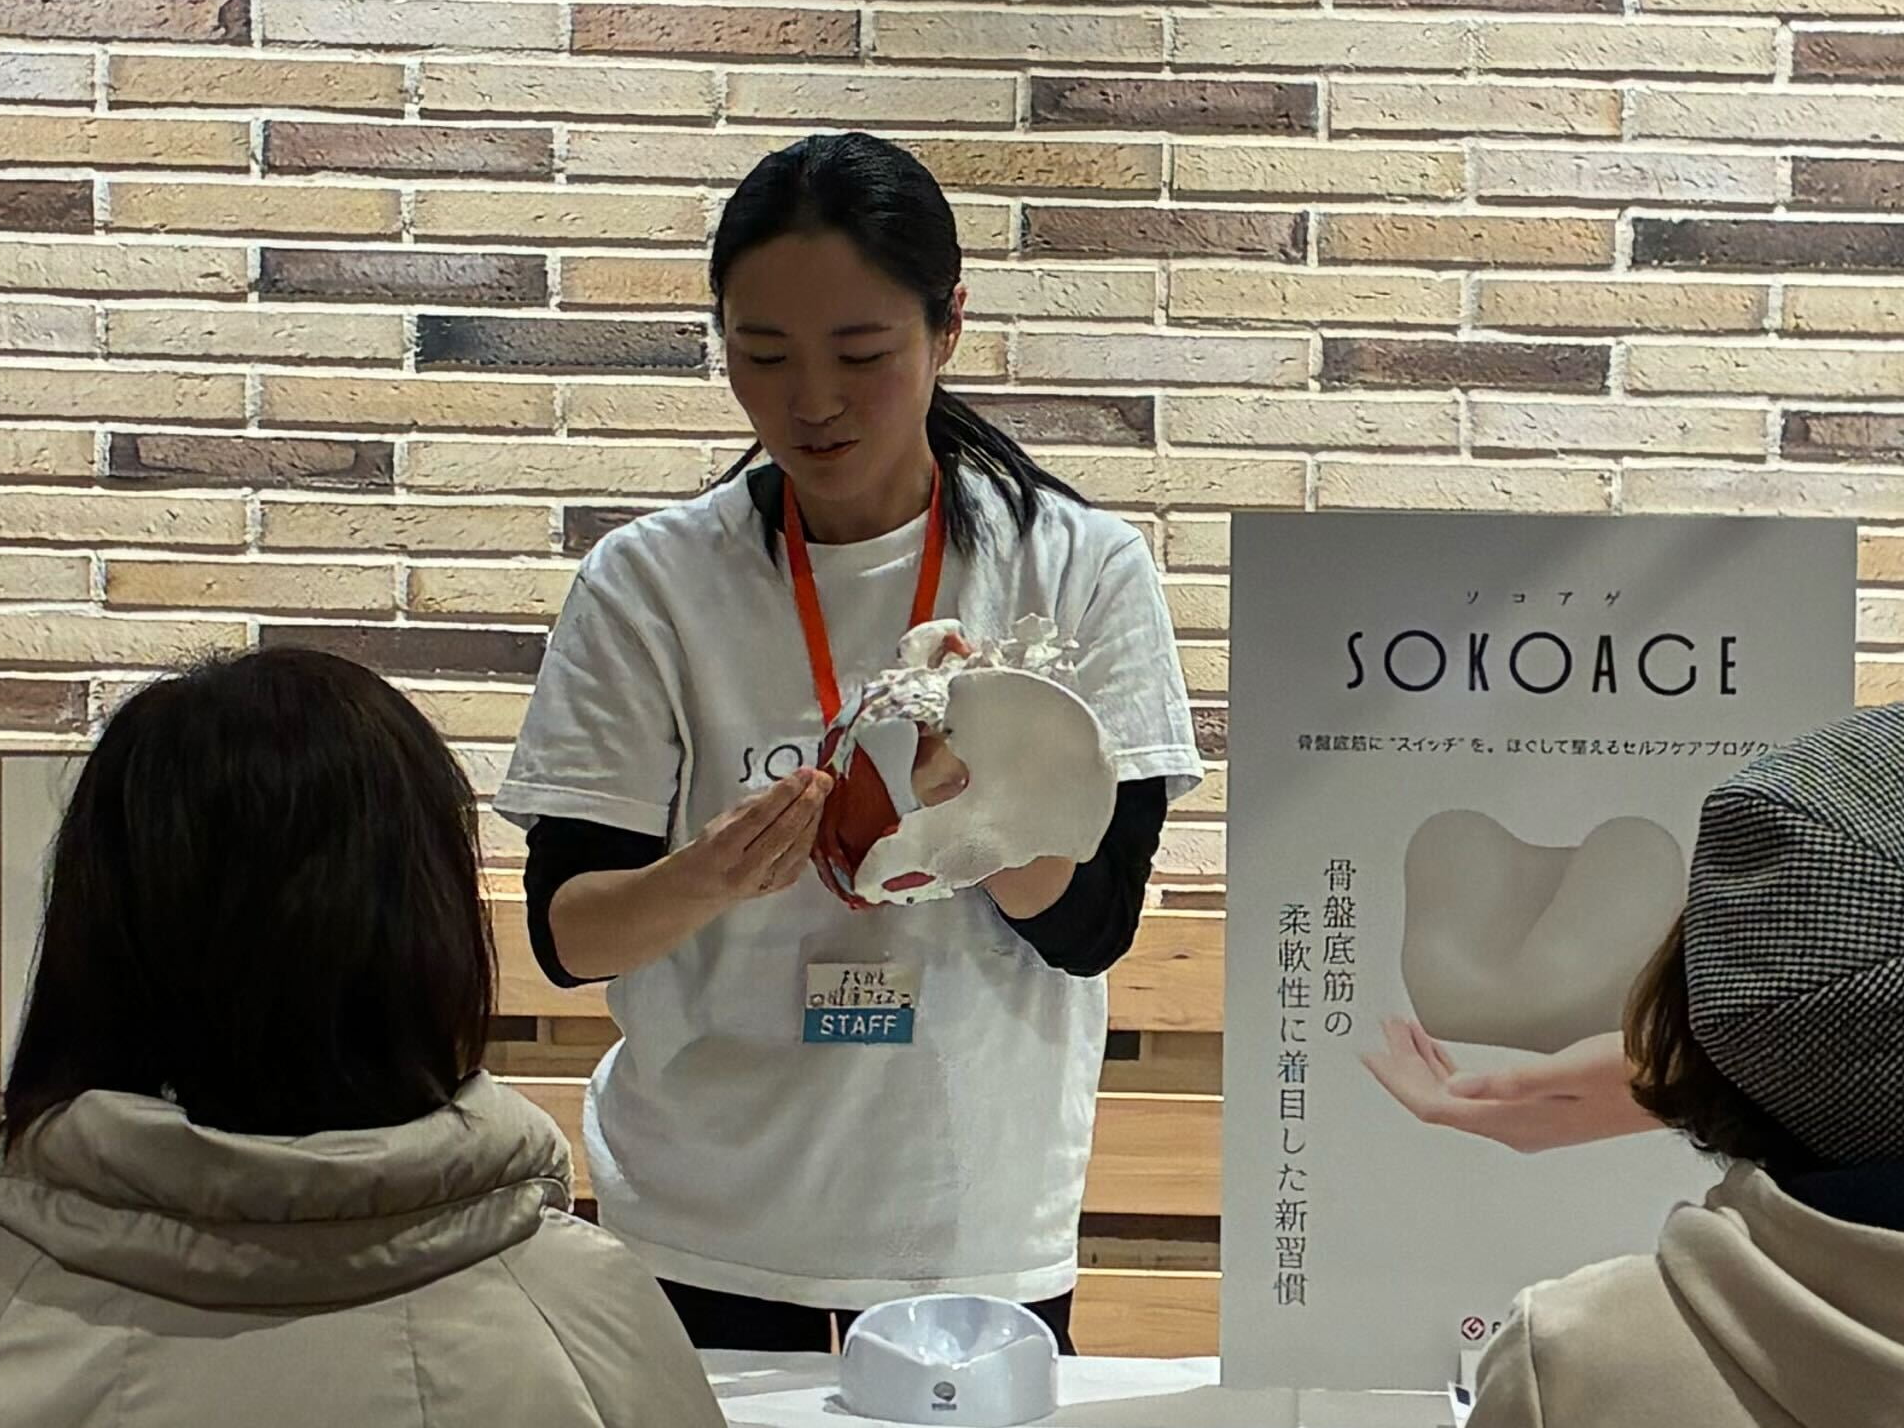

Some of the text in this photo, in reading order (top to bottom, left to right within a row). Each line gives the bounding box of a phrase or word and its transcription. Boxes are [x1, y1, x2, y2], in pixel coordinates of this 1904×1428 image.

[1346, 628, 1738, 697] SOKOAGE
[1322, 858, 1357, 1037] 骨盤底筋の
[820, 1014, 898, 1036] STAFF
[1272, 903, 1312, 1307] 柔軟性に着目した新習慣
